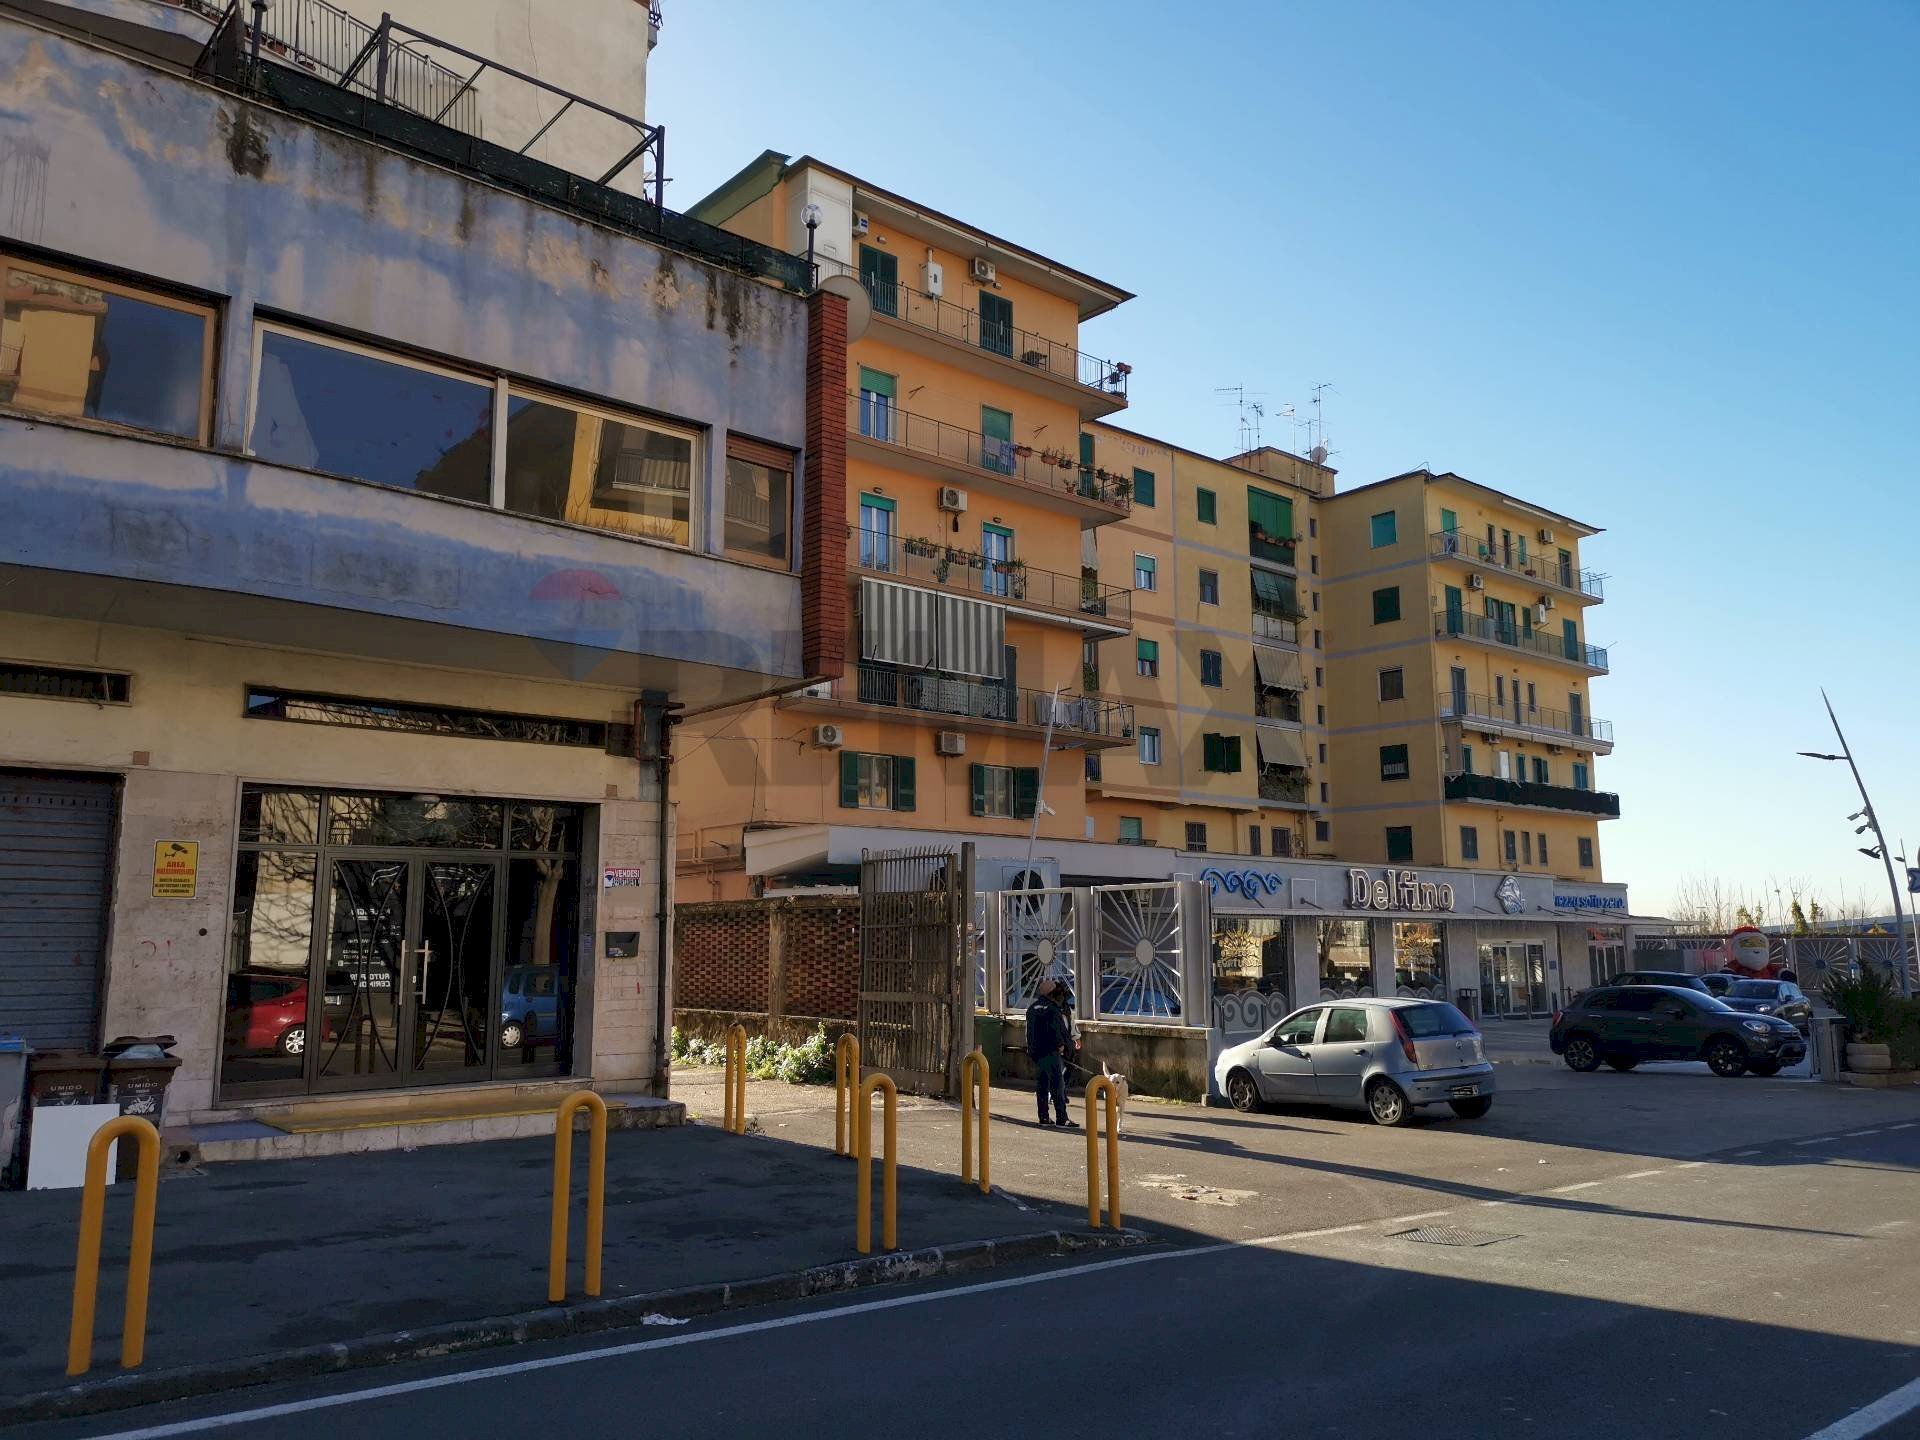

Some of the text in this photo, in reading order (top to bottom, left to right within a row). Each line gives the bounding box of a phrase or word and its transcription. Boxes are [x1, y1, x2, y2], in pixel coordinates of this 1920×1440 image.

[614, 869, 640, 878] VENDESI
[1350, 868, 1454, 911] Delfino
[50, 1084, 82, 1092] UMIDO
